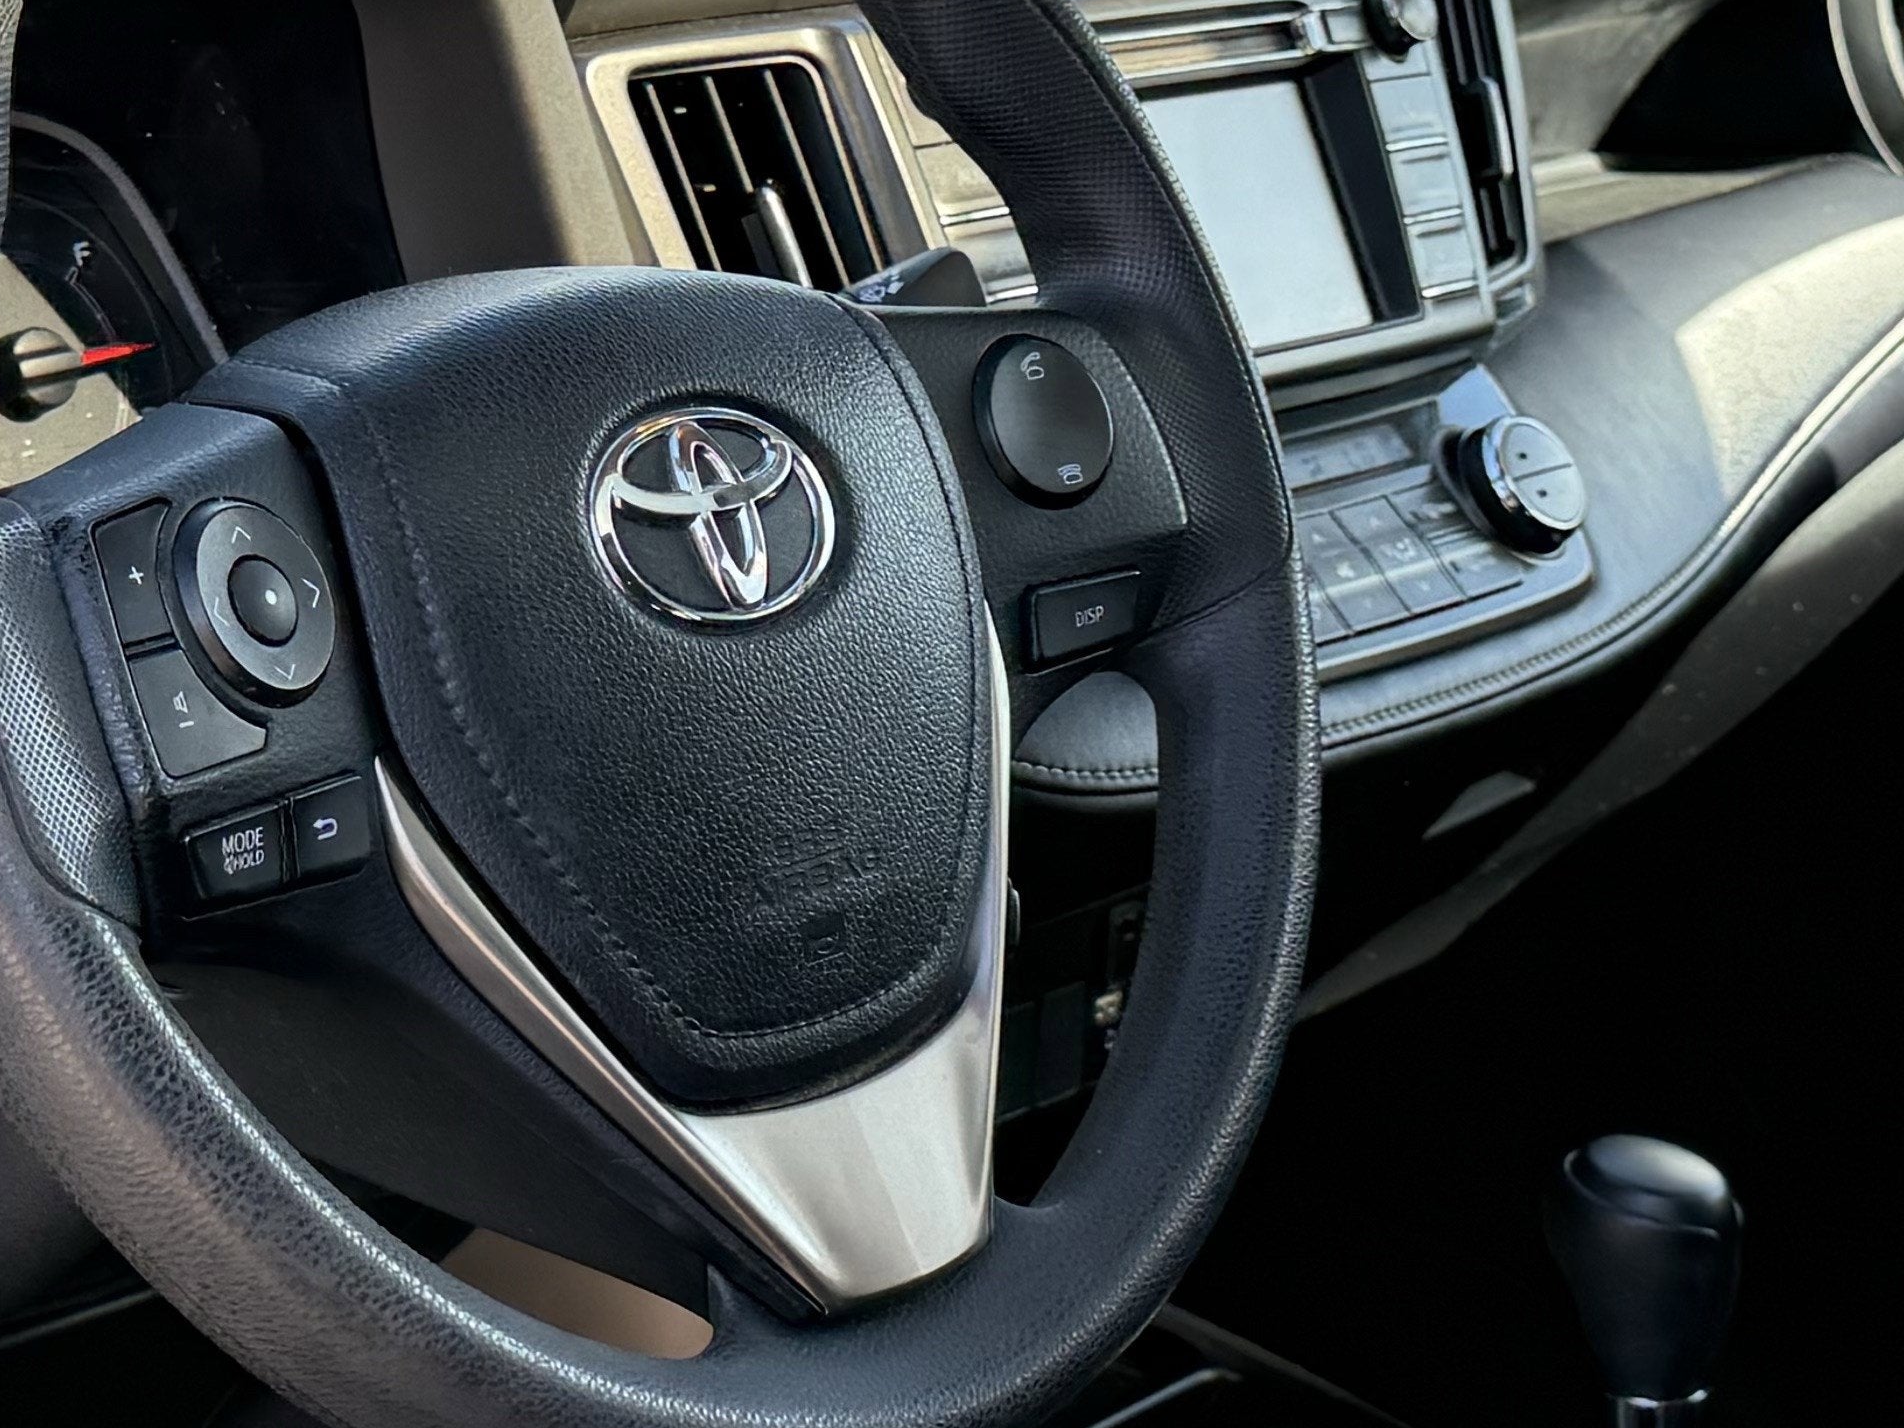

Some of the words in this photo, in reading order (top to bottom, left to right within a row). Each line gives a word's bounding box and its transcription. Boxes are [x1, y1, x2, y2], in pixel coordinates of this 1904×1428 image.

[73, 241, 90, 266] F
[1075, 605, 1104, 627] DISP
[222, 826, 264, 857] MODE
